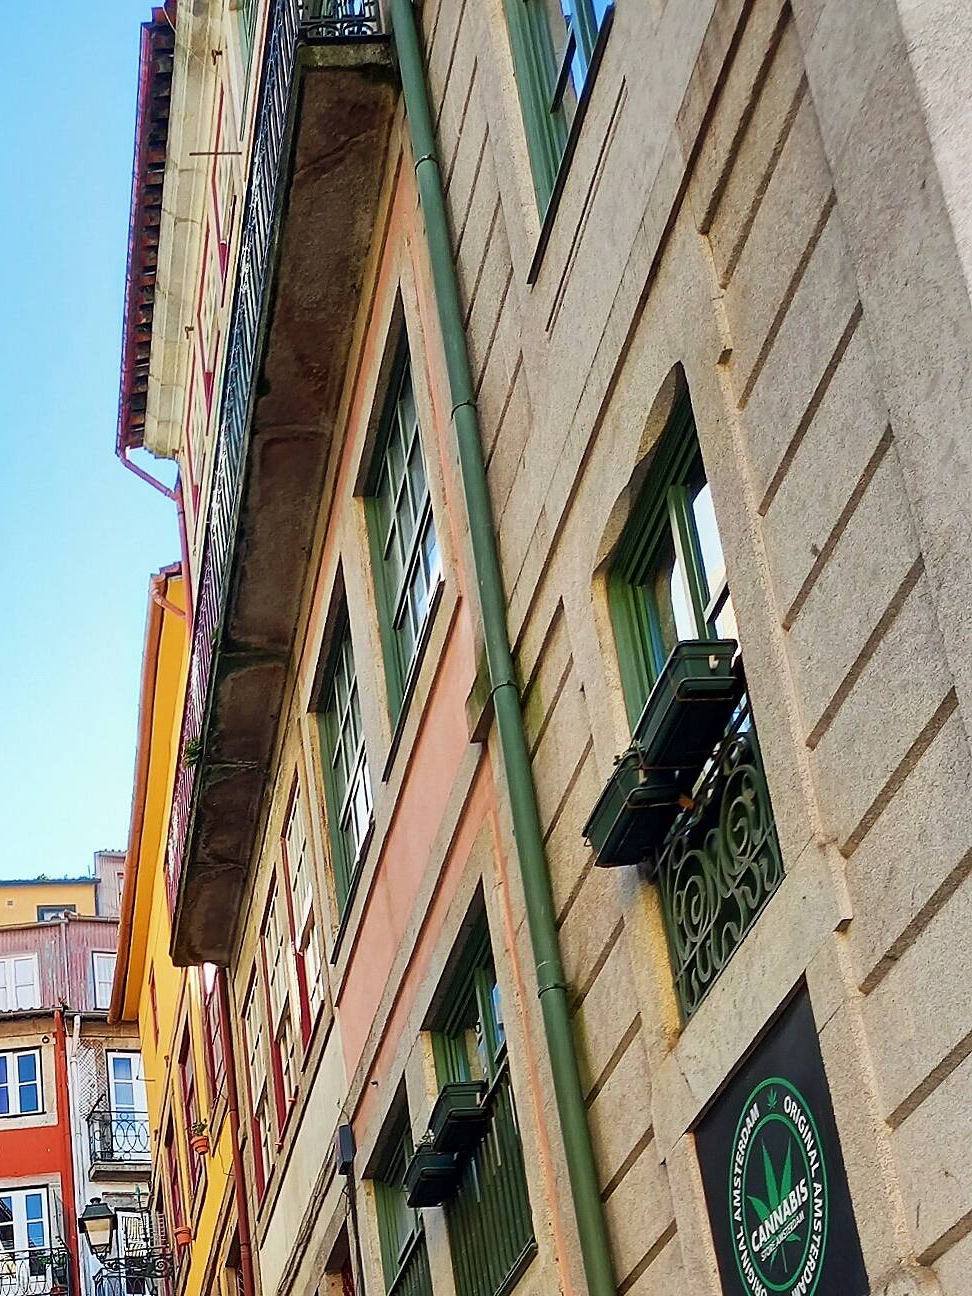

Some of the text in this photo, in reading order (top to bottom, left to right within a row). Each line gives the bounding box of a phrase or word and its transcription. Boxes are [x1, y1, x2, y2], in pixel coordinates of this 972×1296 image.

[732, 1102, 760, 1221] AMSTERDAM
[783, 1095, 821, 1178] ORIGINAL
[751, 1177, 809, 1253] CANNABIS
